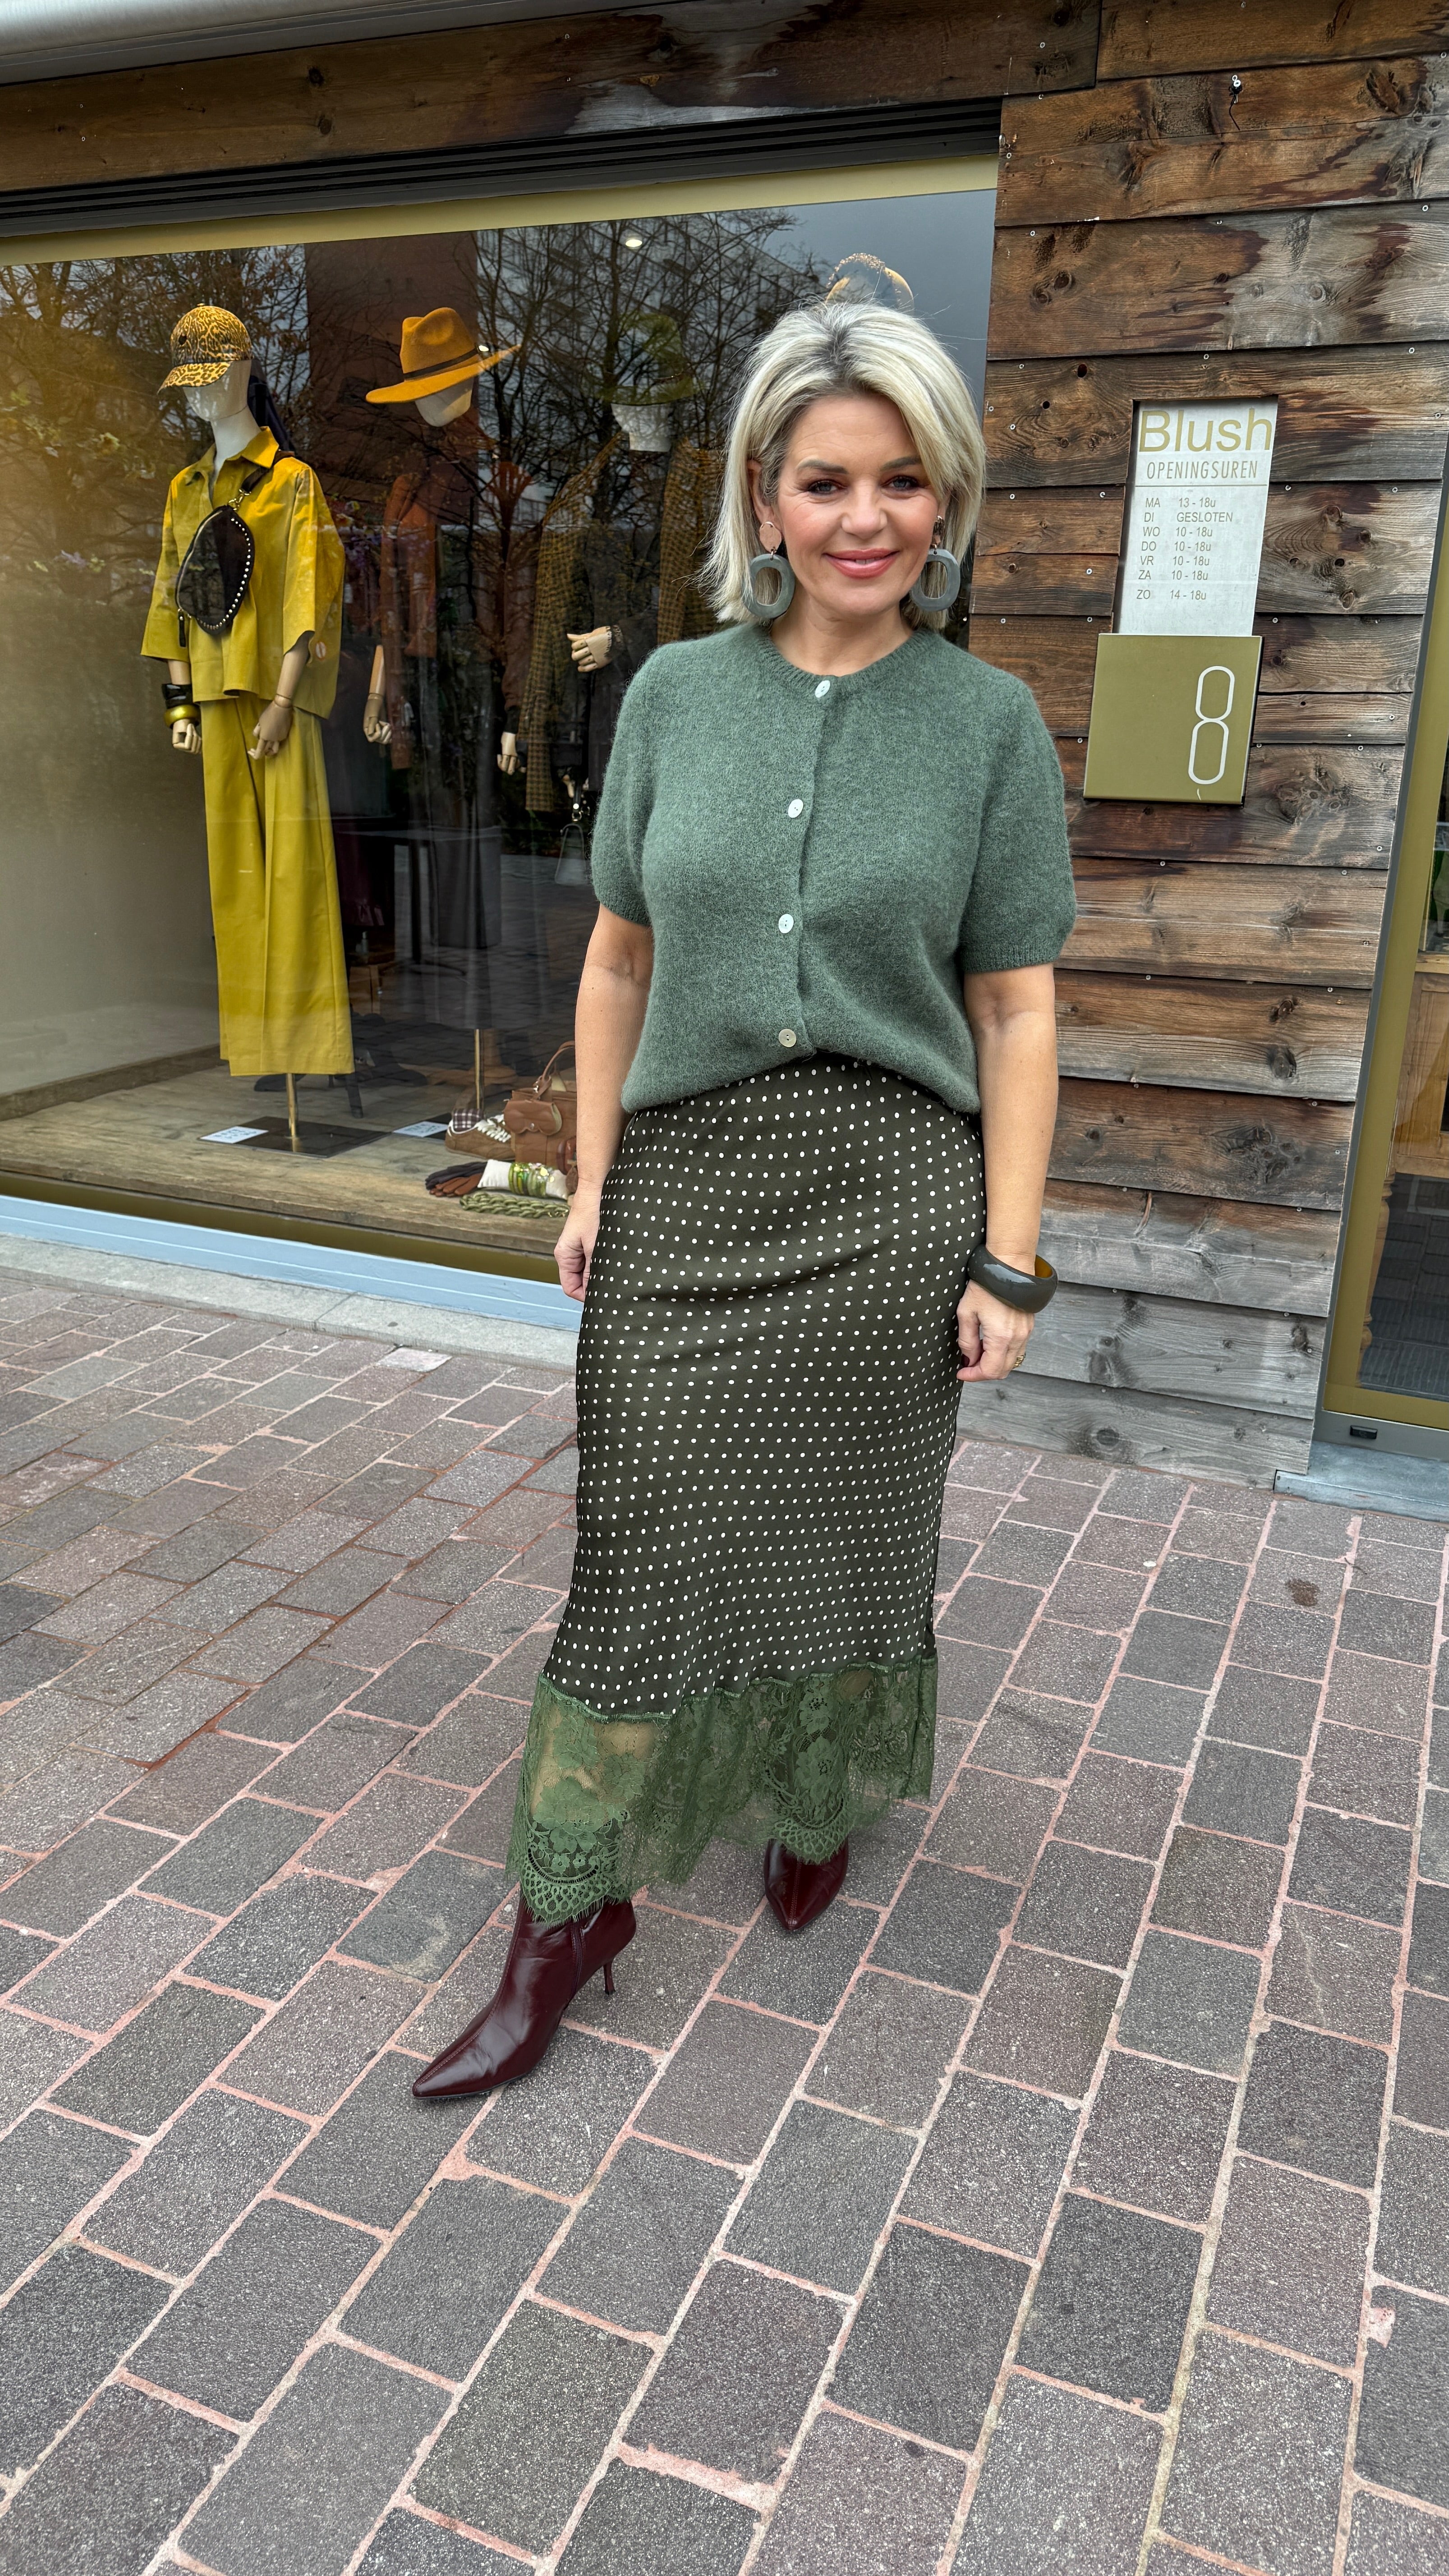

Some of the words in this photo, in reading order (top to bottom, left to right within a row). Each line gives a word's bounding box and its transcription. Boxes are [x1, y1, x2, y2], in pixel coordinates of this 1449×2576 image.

[1139, 408, 1272, 452] Blush
[1147, 460, 1258, 479] OPENINGSUREN
[1145, 497, 1160, 508] MA
[1178, 497, 1189, 508] 13
[1199, 497, 1216, 508] 18u
[1144, 512, 1154, 522] DI
[1177, 512, 1233, 522] GESLOTEN
[1143, 526, 1160, 537] WO
[1176, 526, 1187, 537] 10
[1196, 526, 1213, 537] 18u
[1141, 541, 1156, 551] DO
[1174, 541, 1185, 552] 10
[1195, 541, 1211, 552] 18u
[1140, 555, 1154, 566] VR
[1173, 556, 1183, 566] 10
[1193, 556, 1210, 566] 18u
[1138, 570, 1151, 580] ZA
[1172, 570, 1182, 580] 10
[1192, 570, 1208, 580] 18u
[1136, 589, 1151, 599] ZO
[1170, 589, 1180, 599] 14
[1190, 590, 1206, 600] 18u
[1188, 666, 1235, 784] 8
